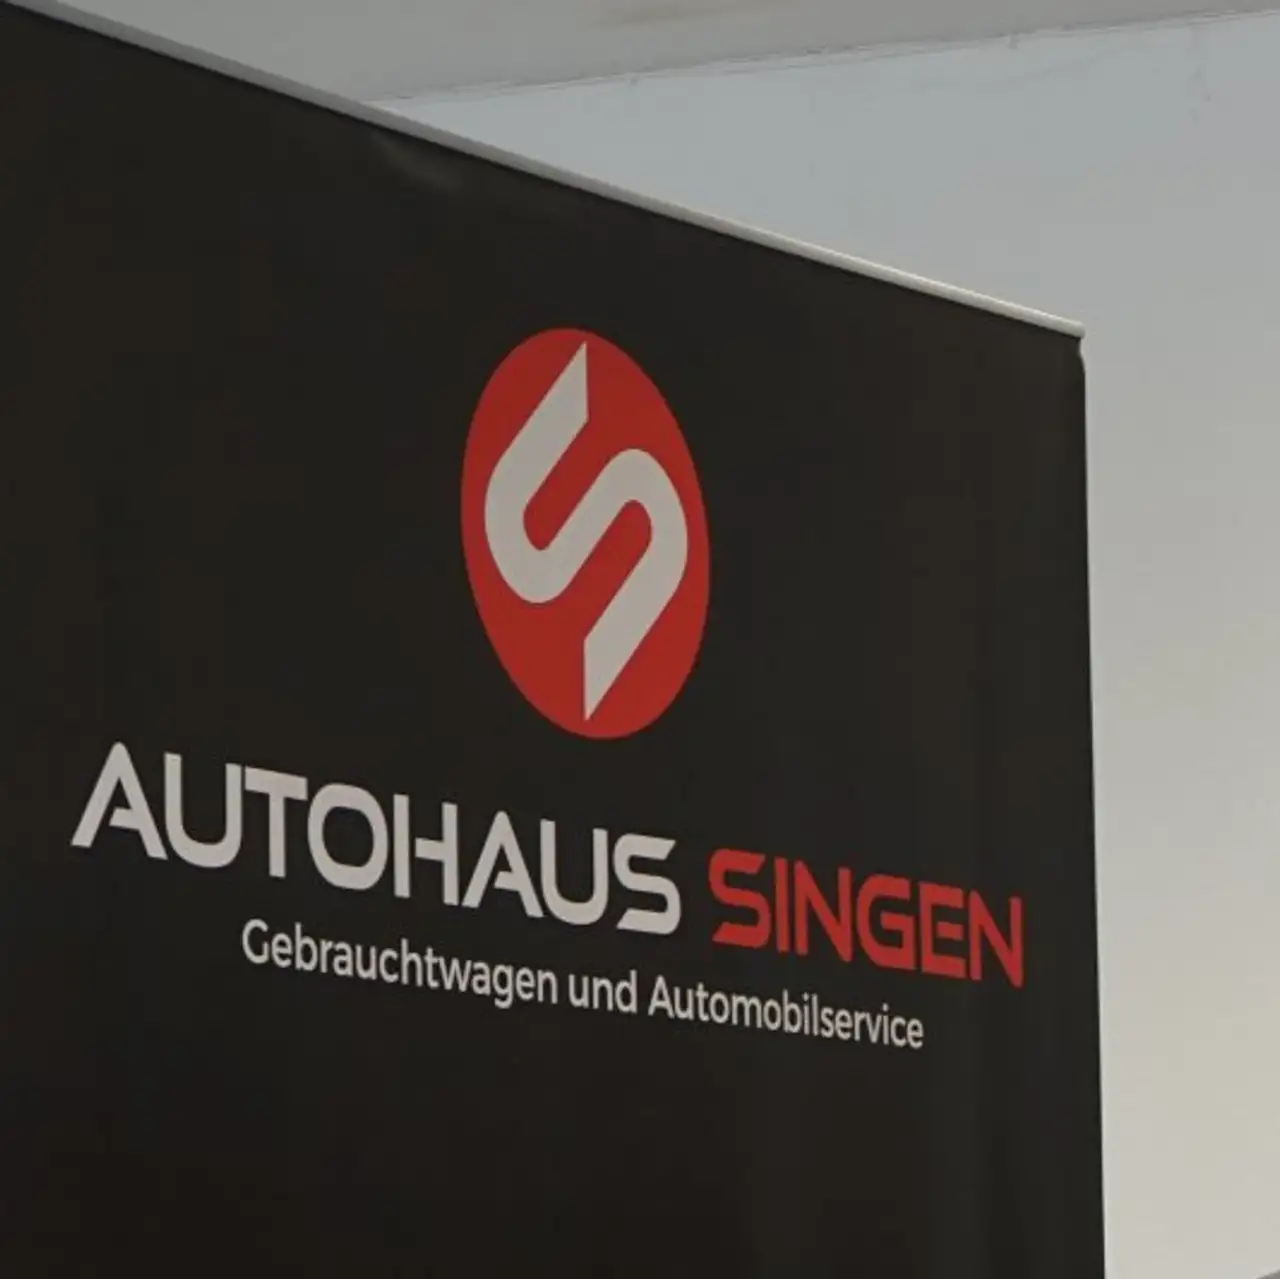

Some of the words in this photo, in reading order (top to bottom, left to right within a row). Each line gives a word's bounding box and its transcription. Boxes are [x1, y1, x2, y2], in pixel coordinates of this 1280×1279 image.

[70, 741, 682, 935] AUTOHAUS
[708, 848, 1024, 988] SINGEN
[242, 918, 558, 1009] Gebrauchtwagen
[568, 969, 638, 1014] und
[647, 975, 925, 1049] Automobilservice
